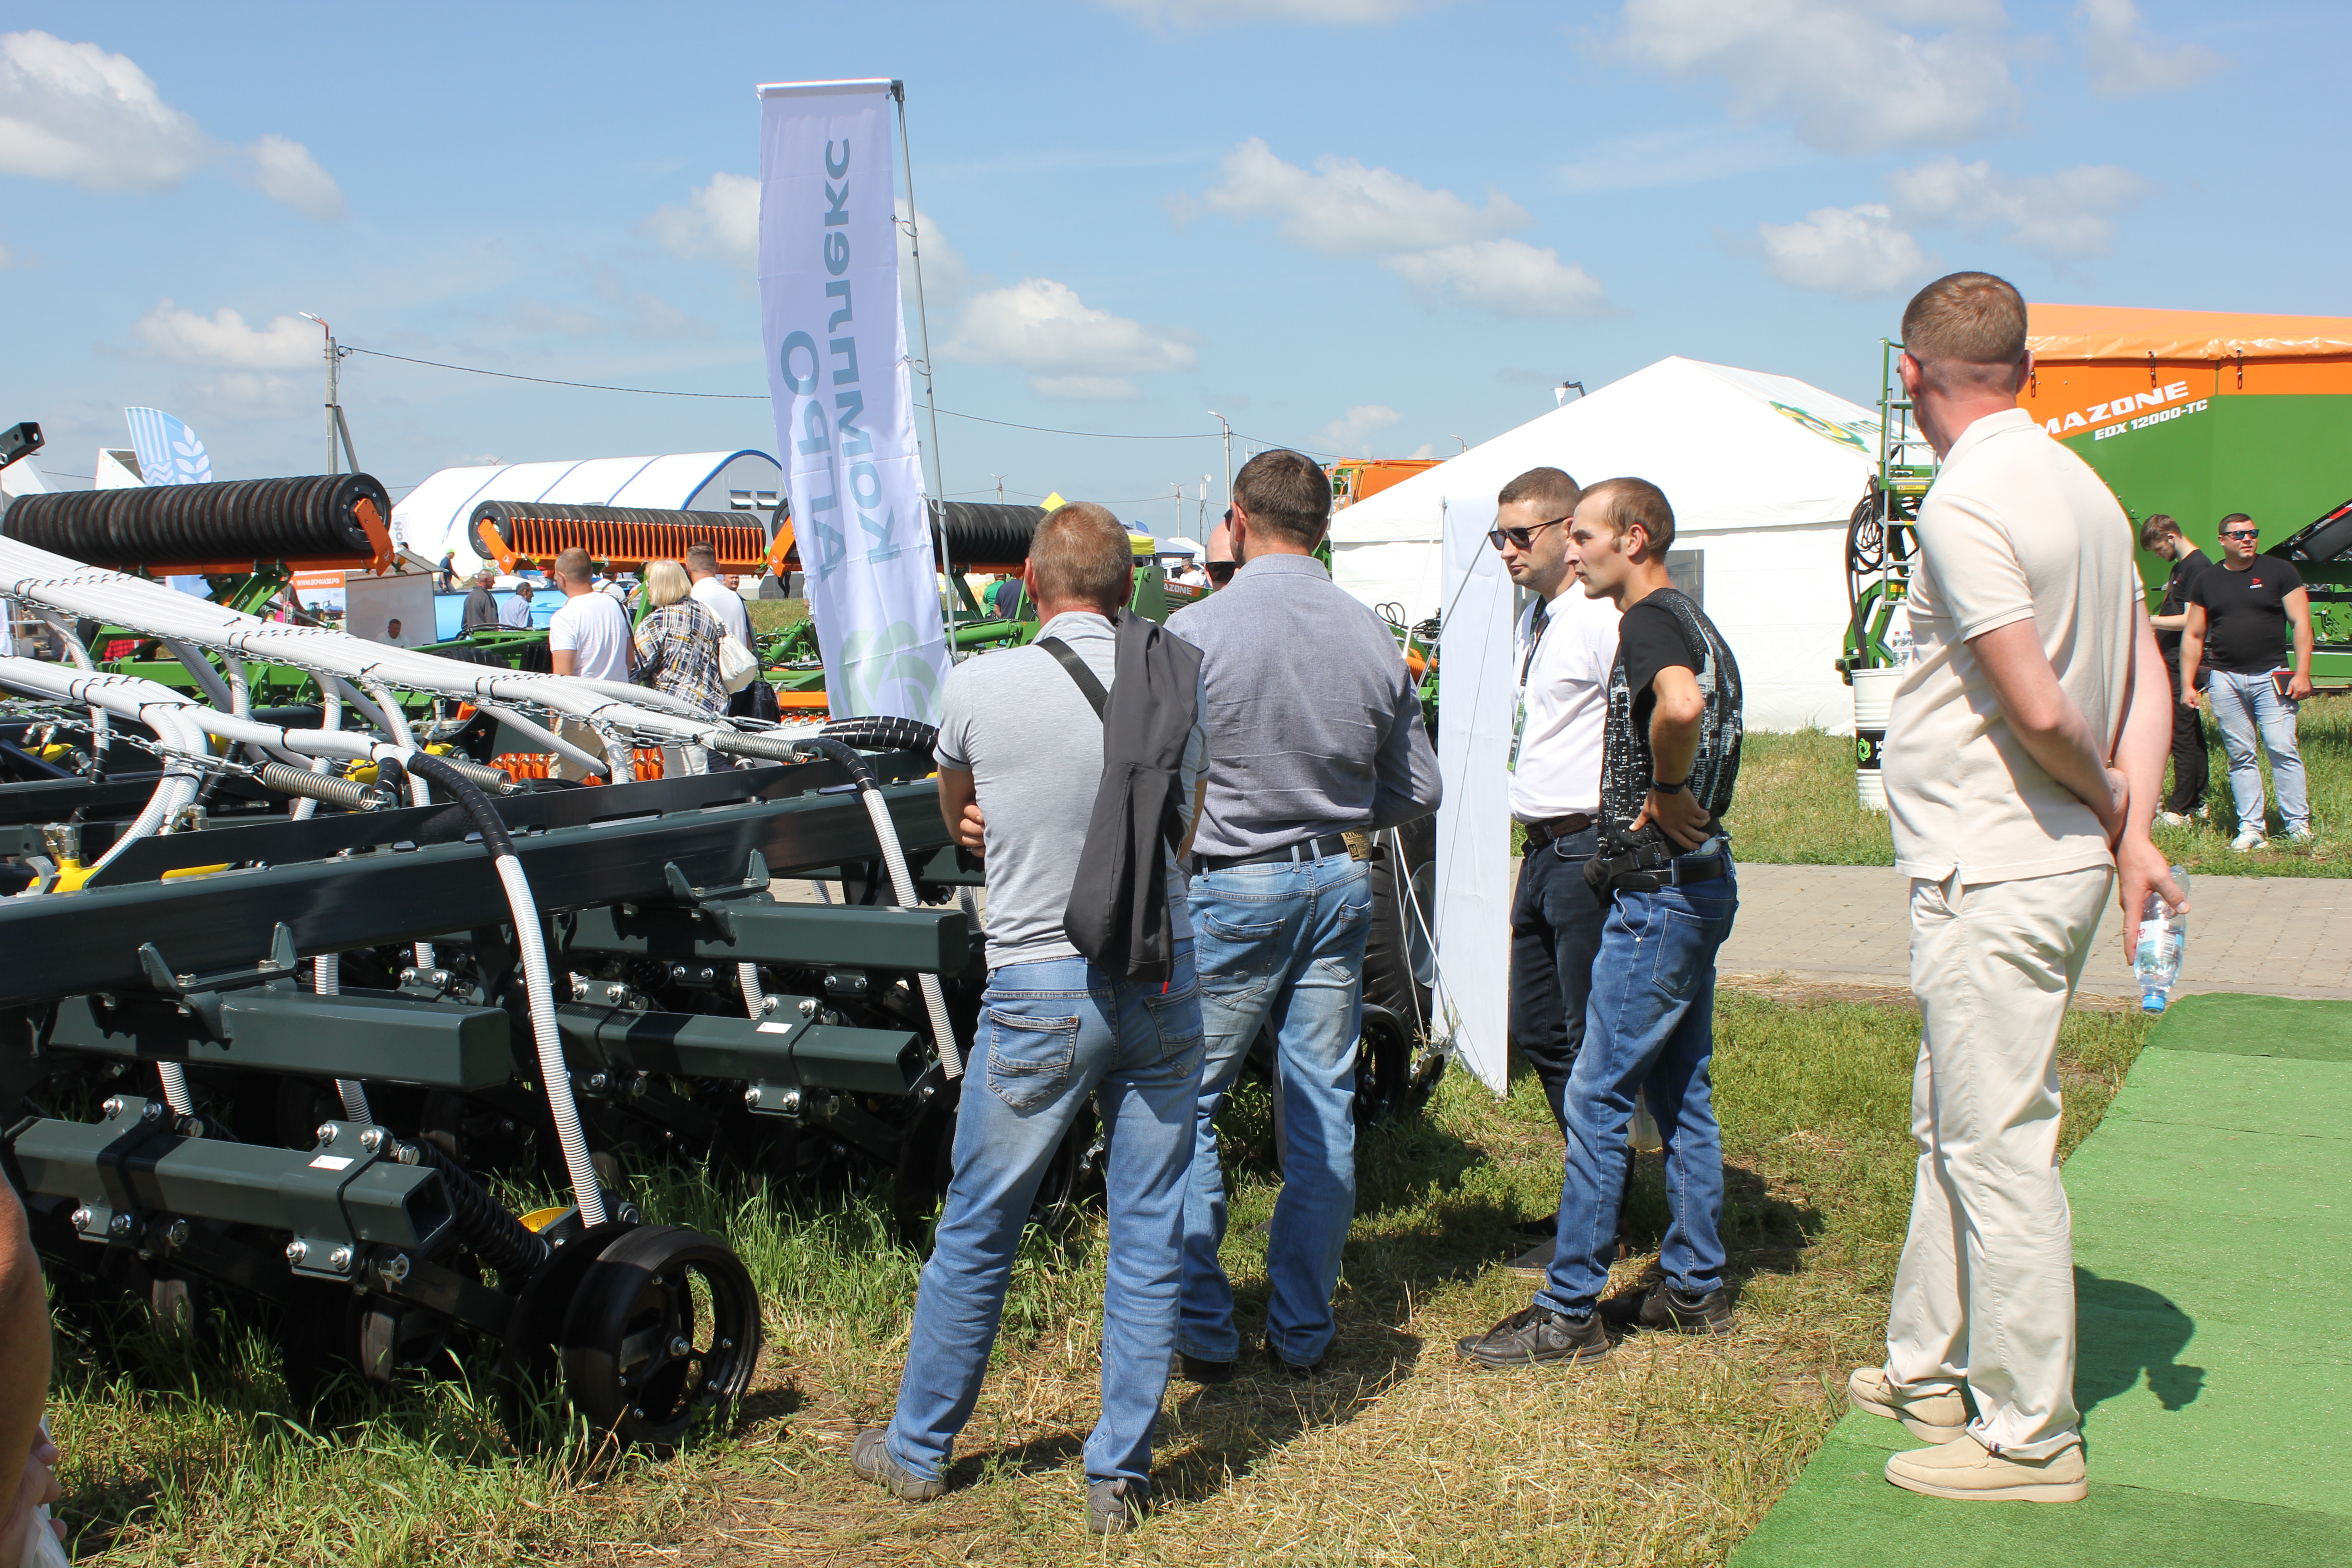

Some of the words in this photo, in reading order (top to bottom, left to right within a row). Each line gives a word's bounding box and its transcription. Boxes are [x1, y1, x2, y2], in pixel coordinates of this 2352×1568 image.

[2035, 380, 2189, 435] MAZONE
[2094, 422, 2127, 441] EDX
[2130, 398, 2208, 430] 12000-TC
[1163, 583, 1192, 595] AZONE
